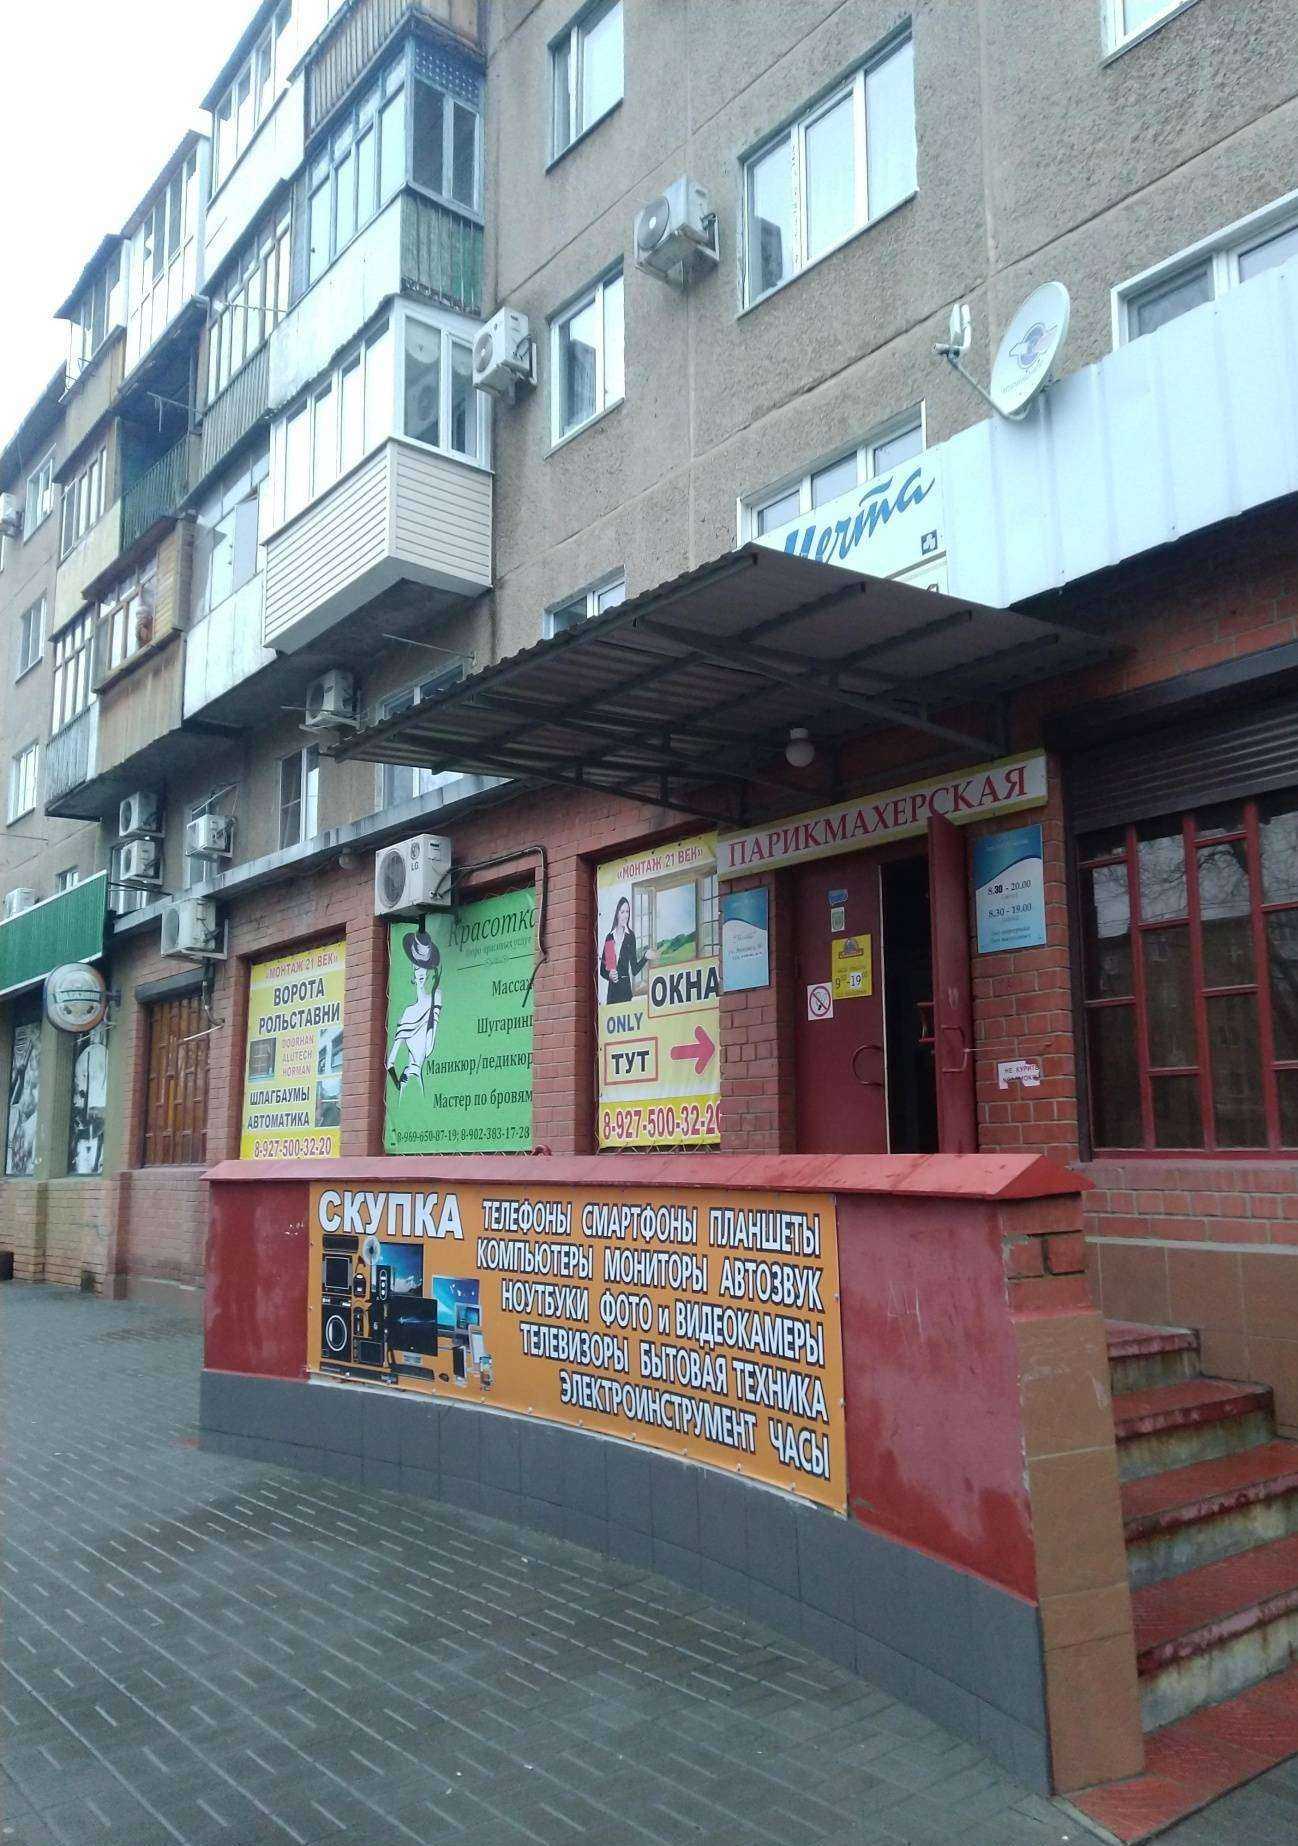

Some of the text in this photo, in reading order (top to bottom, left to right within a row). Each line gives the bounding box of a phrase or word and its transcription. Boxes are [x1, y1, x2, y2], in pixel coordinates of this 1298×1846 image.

[728, 765, 1028, 868] ПАРИКМАХЕРСКАЯ
[665, 853, 675, 868] 21
[273, 977, 325, 1007] ВОРОТА
[651, 966, 720, 1008] ОКНА
[259, 1002, 341, 1035] РОЛЬСТАВНИ
[606, 1012, 644, 1034] ONLY
[611, 1049, 650, 1075] ТУТ
[250, 1086, 310, 1106] ШЛАГБАУМЫ
[433, 1093, 472, 1111] Мастер
[474, 1093, 487, 1106] по
[247, 1111, 310, 1130] АВТОМАТИКА
[254, 1136, 332, 1159] 8-927-500-32-20
[318, 1190, 465, 1240] СКУПКА
[482, 1198, 821, 1256] ТЕЛЕФОНЫ СМАРТФОНЫ ПЛАНШЕТЫ
[476, 1238, 825, 1313] КОМПЬЮТЕРЫ МОНИТОРЫ АВТОЗВУК
[501, 1277, 589, 1323] НОУТБУКИ
[599, 1290, 653, 1332] ФОТО
[675, 1299, 826, 1369] ВИДЕОКАМЕРЫ
[520, 1321, 829, 1425] ТЕЛЕВИЗОРЫ БЫТОВАЯ ТЕХНИКА
[559, 1370, 831, 1481] ЭЛЕКТРОИНСТРУМЕНТ ЧАСЫ
